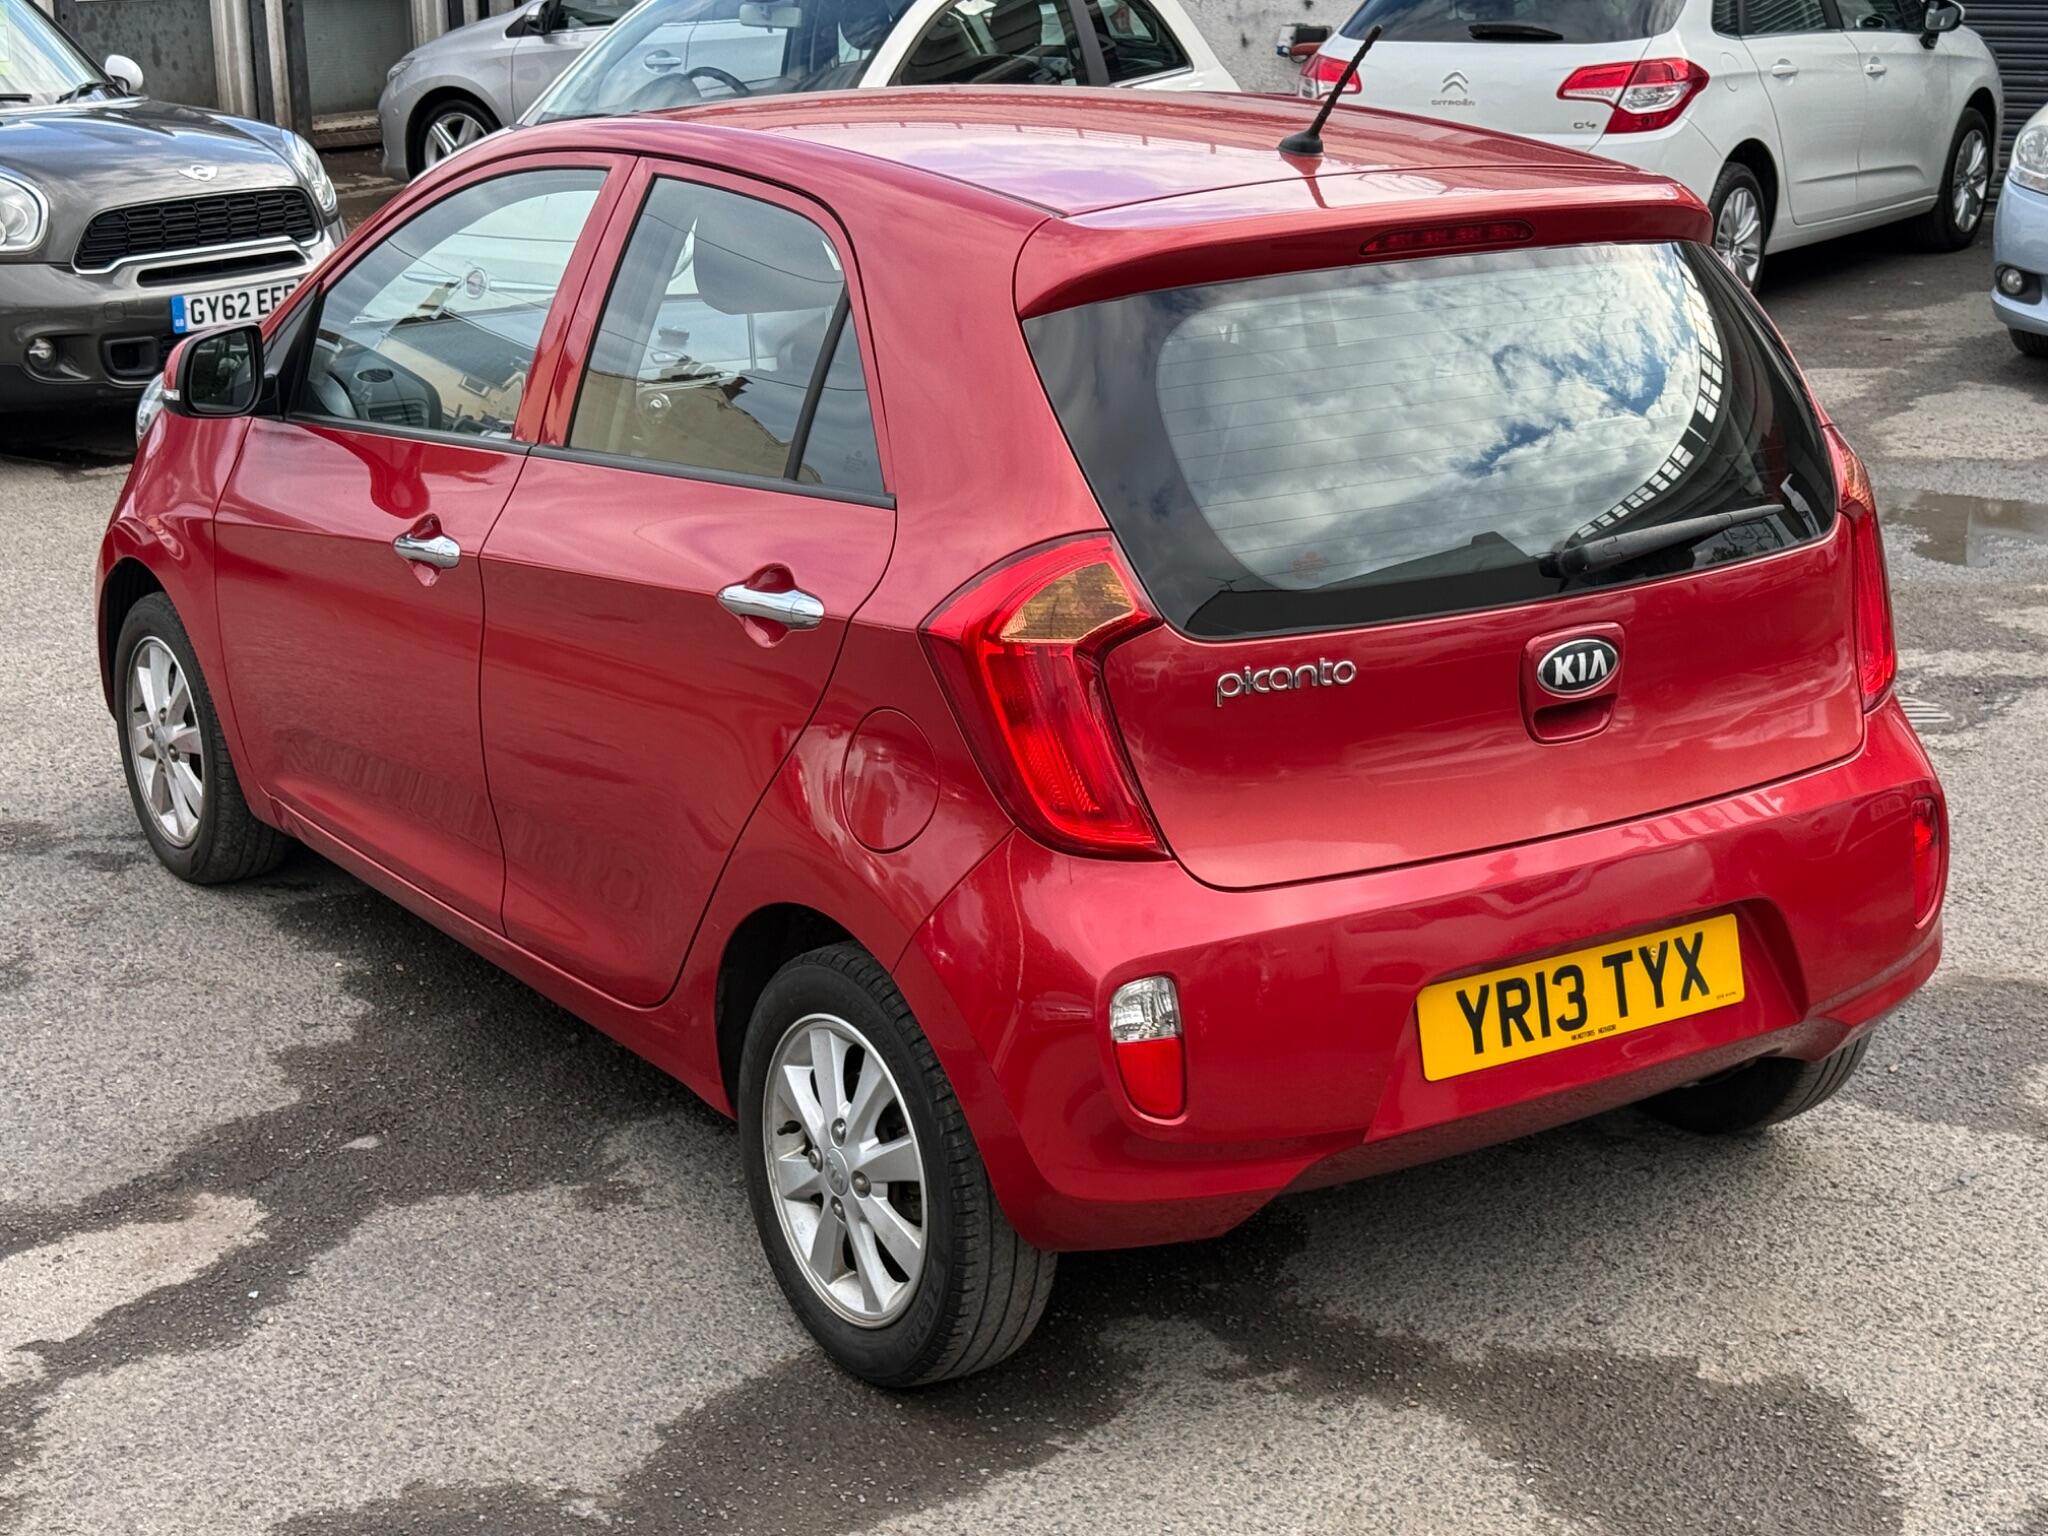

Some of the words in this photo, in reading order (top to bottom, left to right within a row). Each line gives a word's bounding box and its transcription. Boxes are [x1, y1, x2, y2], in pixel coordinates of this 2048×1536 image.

[1573, 121, 1596, 130] C4
[190, 291, 252, 326] GY62
[1217, 657, 1357, 707] picanto
[1553, 649, 1608, 686] KIA
[1456, 964, 1589, 1055] YR13
[1602, 931, 1711, 1019] TYX
